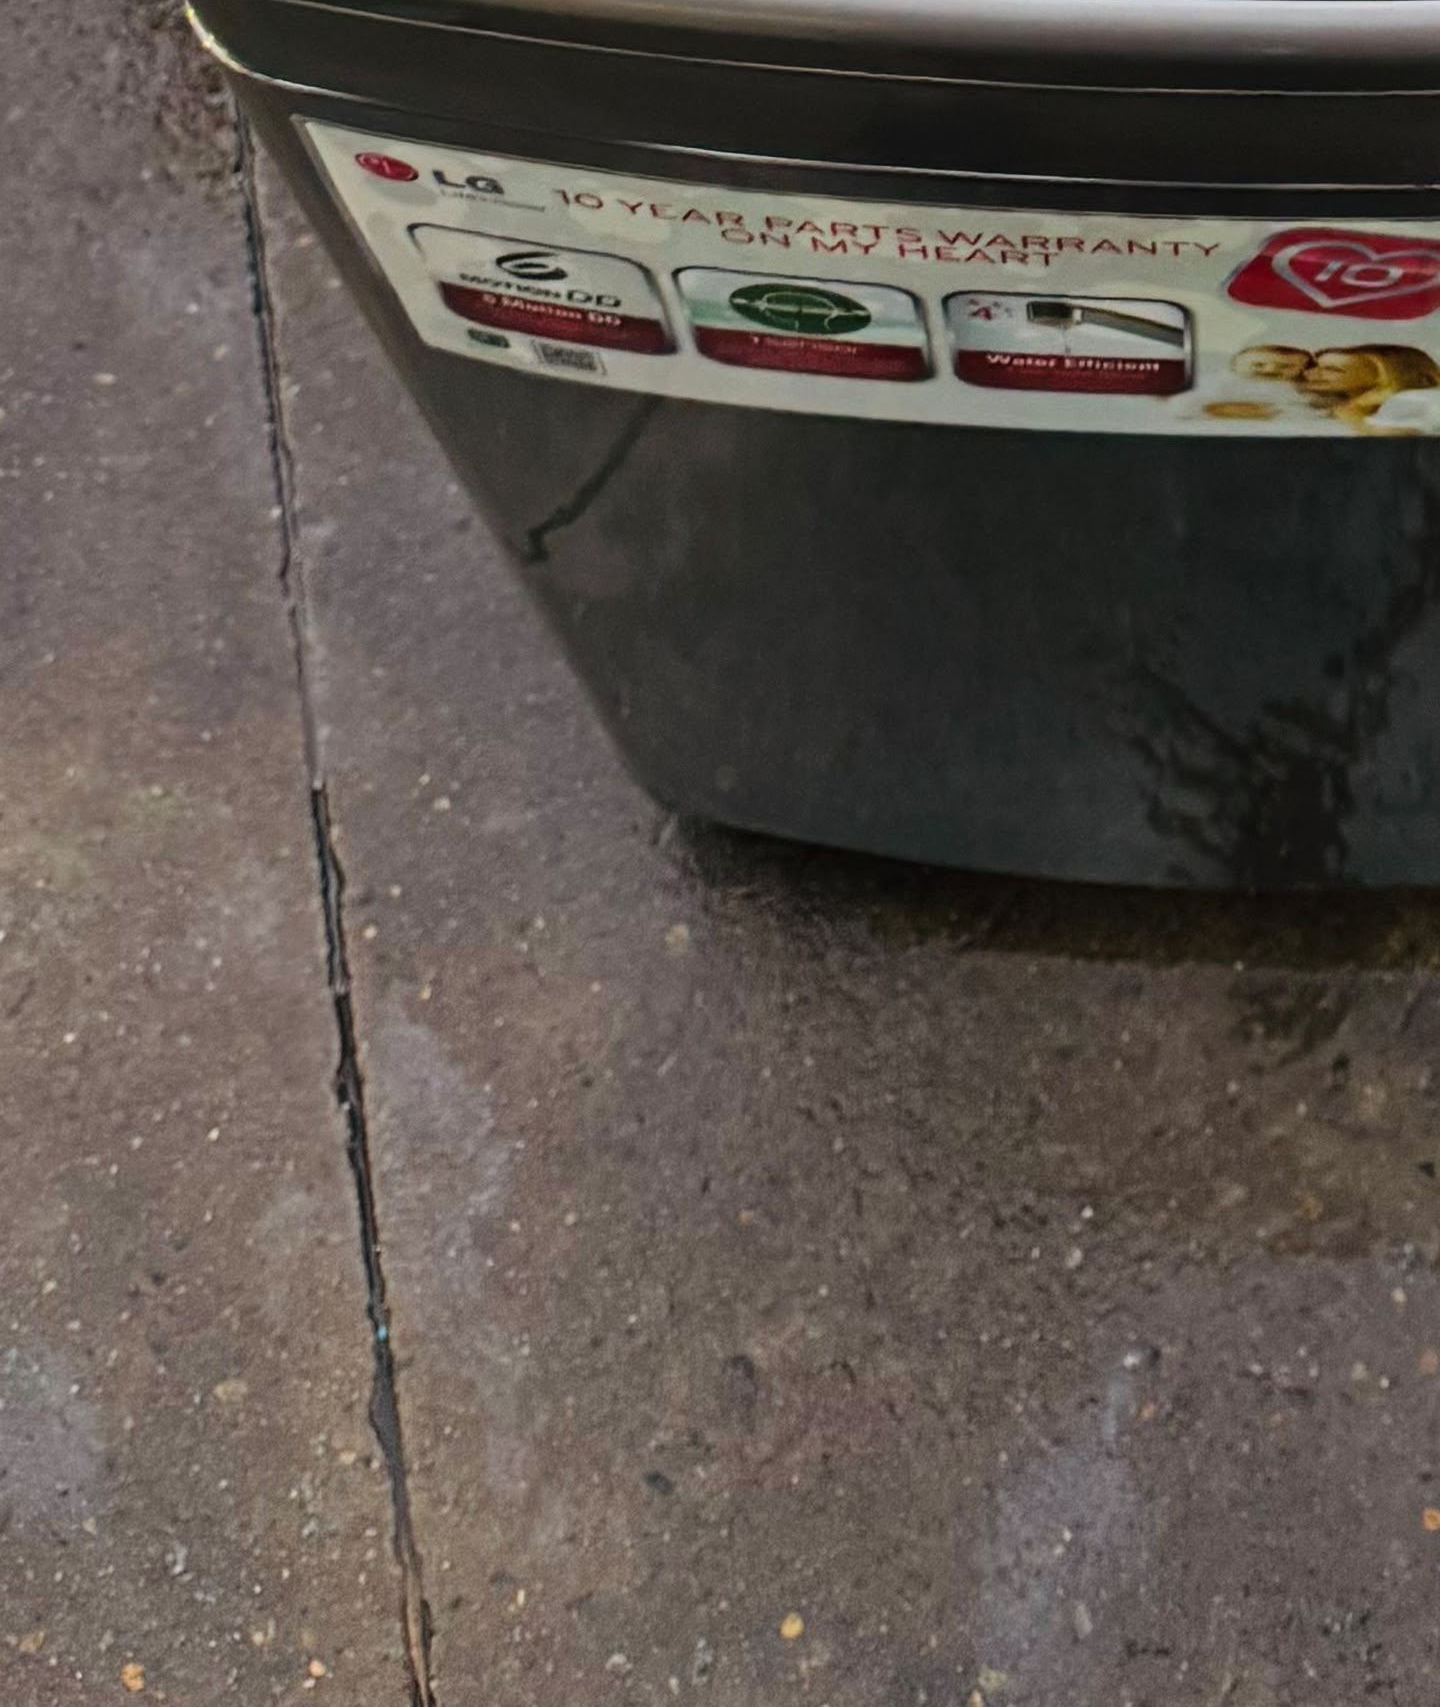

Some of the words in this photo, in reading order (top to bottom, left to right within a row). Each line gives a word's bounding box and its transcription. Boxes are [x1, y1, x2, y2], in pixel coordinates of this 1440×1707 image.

[555, 189, 604, 210] 10
[616, 198, 744, 228] YEAR
[765, 215, 923, 243] PARTS
[936, 229, 1221, 258] WARRANTY
[721, 227, 790, 249] ON
[811, 236, 882, 255] MY
[898, 243, 1061, 267] HEART
[1315, 261, 1403, 286] 10
[987, 353, 1056, 368] Water
